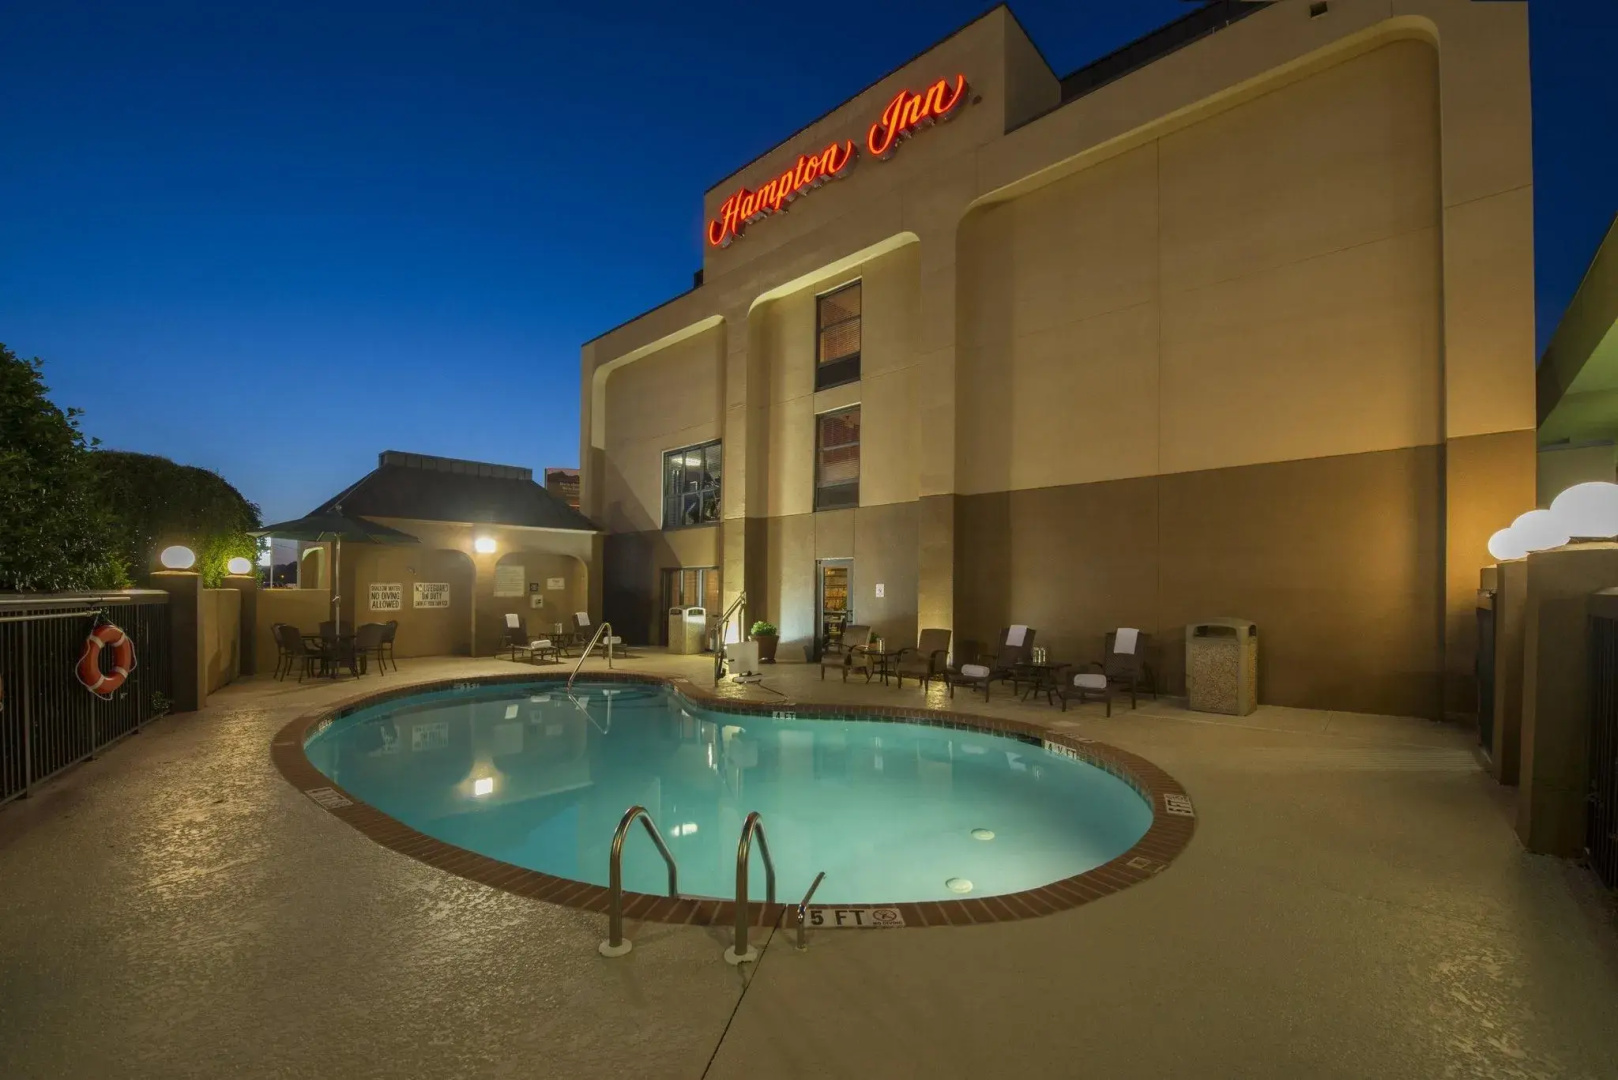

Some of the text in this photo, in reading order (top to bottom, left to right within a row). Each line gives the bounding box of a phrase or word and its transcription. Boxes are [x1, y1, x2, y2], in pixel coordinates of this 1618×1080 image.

[708, 74, 964, 246] Hampton Inn
[371, 592, 400, 600] NO DIVING
[371, 600, 400, 609] ALLOWED
[1066, 748, 1076, 759] FT
[810, 910, 865, 926] 5 FT
